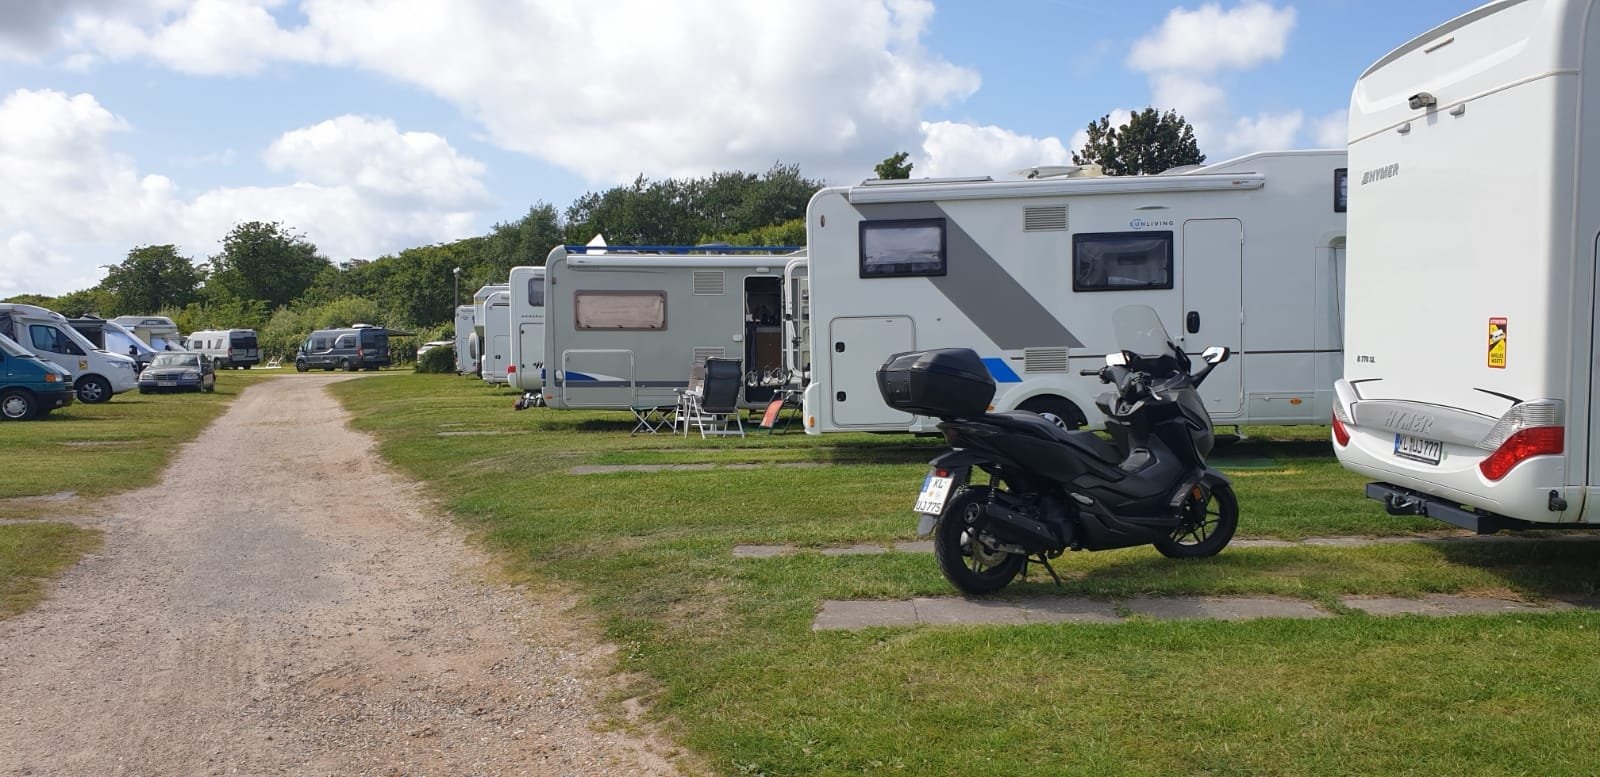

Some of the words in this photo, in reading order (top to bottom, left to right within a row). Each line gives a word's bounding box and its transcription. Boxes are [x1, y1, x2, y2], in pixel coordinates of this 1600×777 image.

[1368, 162, 1400, 184] HYMER
[1129, 219, 1174, 230] SUNLIVING
[1384, 410, 1433, 434] HYMER
[933, 478, 944, 489] KL
[916, 500, 942, 513] UJ775
